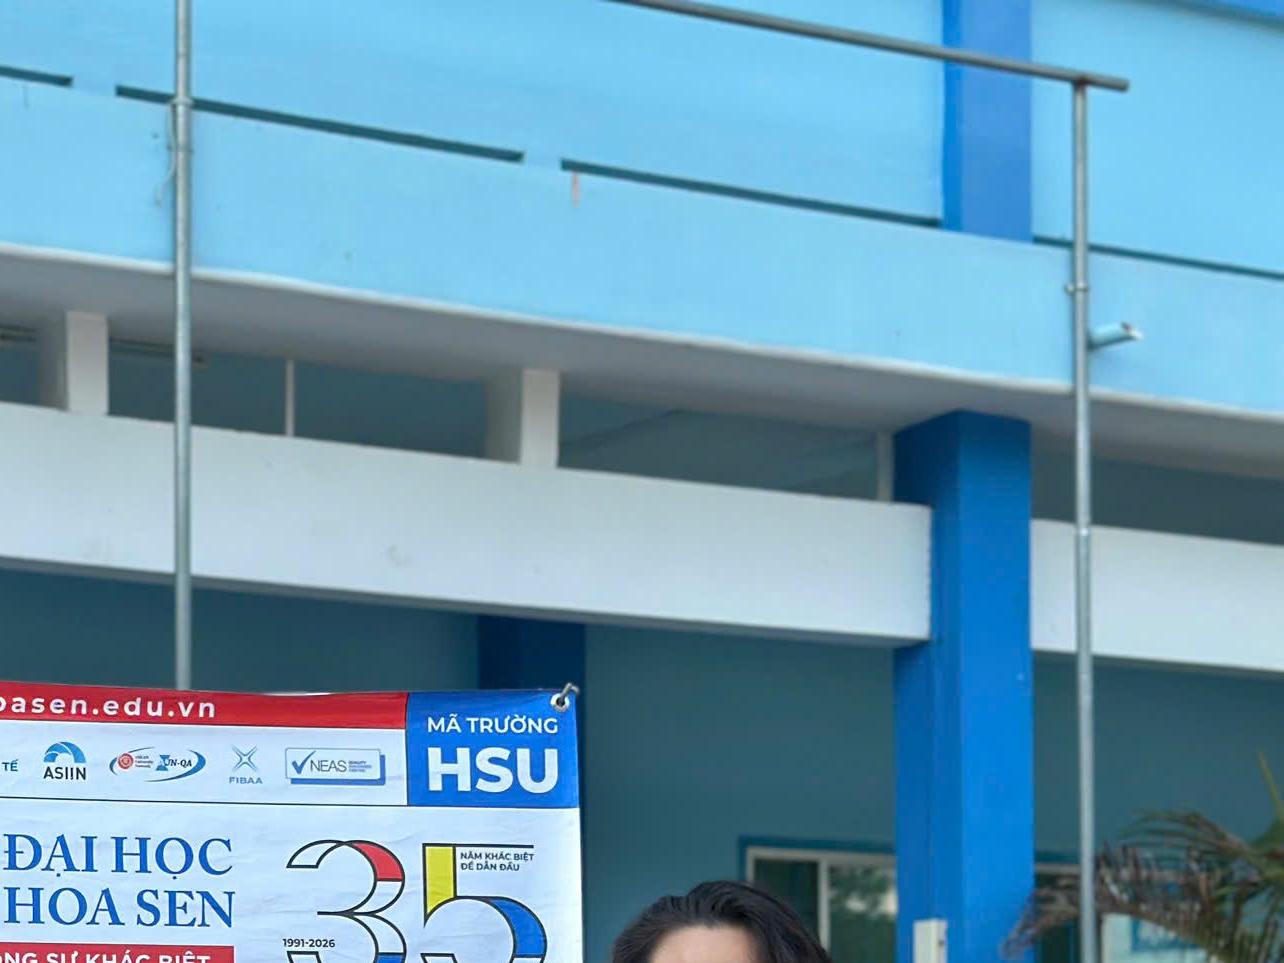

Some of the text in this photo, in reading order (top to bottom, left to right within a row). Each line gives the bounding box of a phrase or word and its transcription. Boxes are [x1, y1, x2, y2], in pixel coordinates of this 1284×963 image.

[427, 713, 557, 733] MÃ TRƯỜNG
[1, 760, 18, 771] TẾ
[310, 759, 348, 773] NEAS
[427, 746, 558, 793] HSU
[229, 776, 263, 785] FIBAA
[2, 833, 232, 879] ĐẠI HỌC
[3, 886, 235, 927] HOA SEN
[282, 938, 335, 947] 1991-2026
